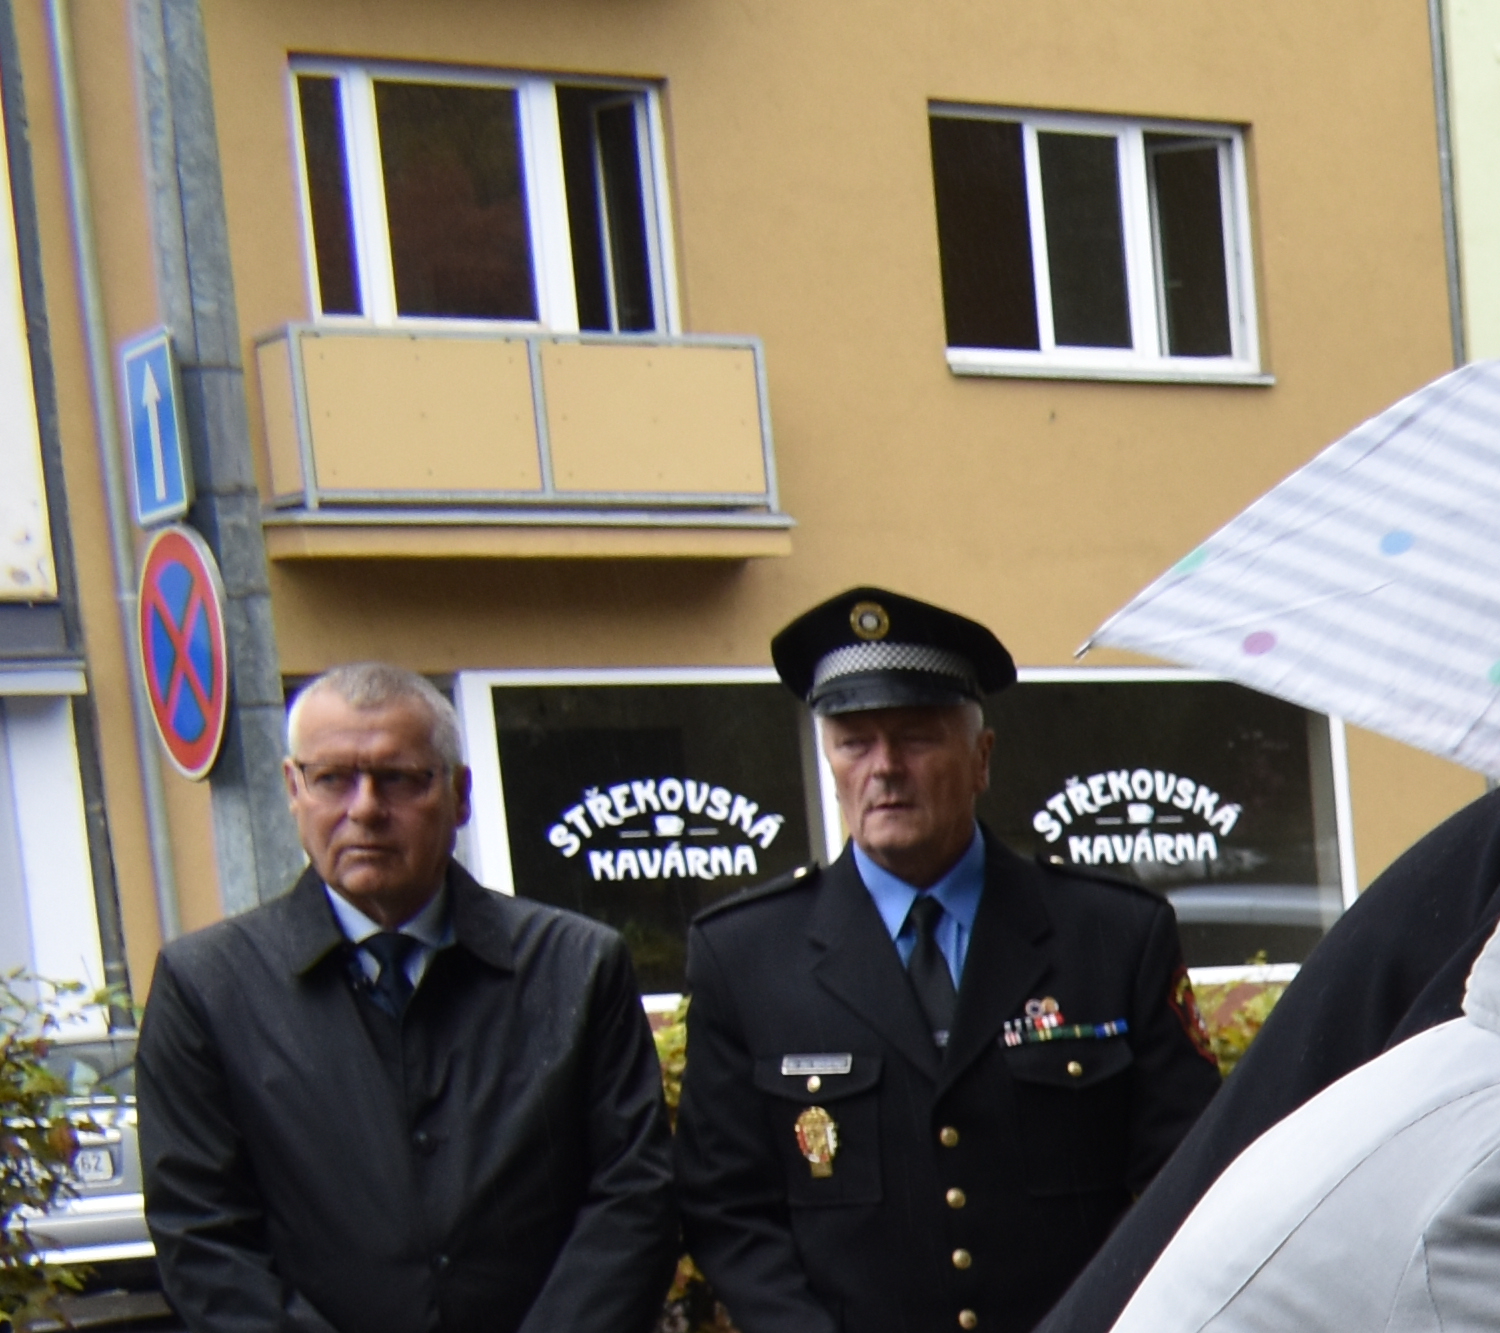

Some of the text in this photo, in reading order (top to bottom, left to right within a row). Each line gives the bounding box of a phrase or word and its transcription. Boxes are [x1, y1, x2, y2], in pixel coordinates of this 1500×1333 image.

[548, 777, 786, 858] STŘEKOVSKÁ
[1033, 768, 1243, 843] STŘEKOVSKÁ
[588, 841, 758, 881] KAVÁRNA
[1068, 828, 1218, 864] KAVÁRNA
